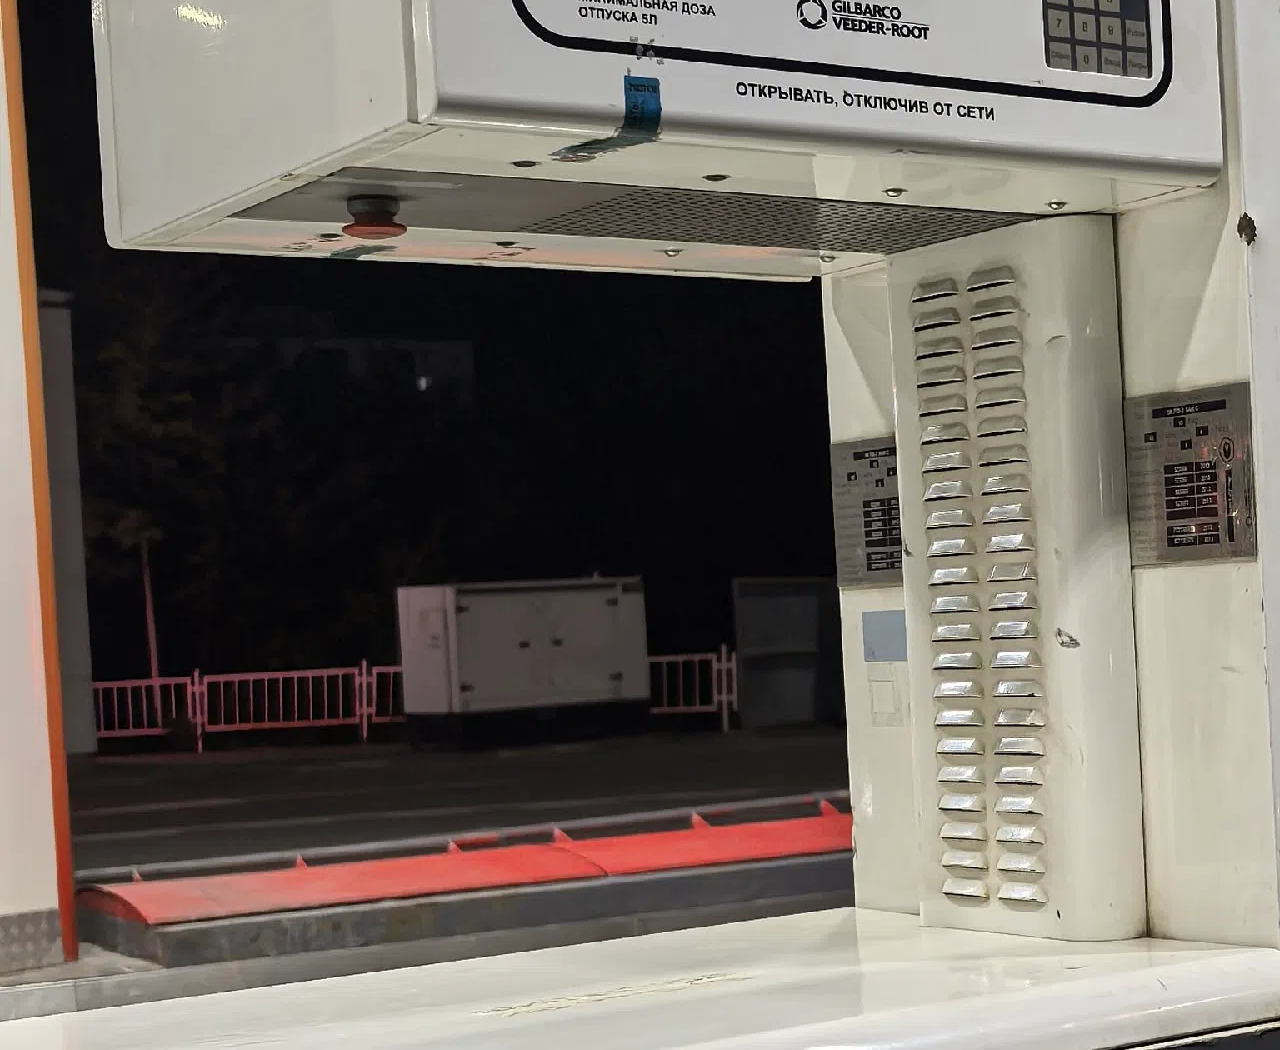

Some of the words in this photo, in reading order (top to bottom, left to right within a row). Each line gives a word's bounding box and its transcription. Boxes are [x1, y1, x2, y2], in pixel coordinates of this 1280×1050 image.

[578, 6, 638, 23] ОТПУСКА
[641, 13, 658, 25] 5Л
[681, 2, 716, 16] ДОЗА
[831, 0, 902, 20] GILBARCO
[831, 16, 930, 40] VEEDER-ROOT
[1056, 18, 1062, 28] 7
[1107, 25, 1113, 35] 9
[736, 81, 839, 107] ОТКРЫВАТЬ,
[842, 91, 929, 114] ОТКЛЮЧИВ
[933, 102, 952, 116] ОТ
[957, 104, 995, 121] СЕТИ
